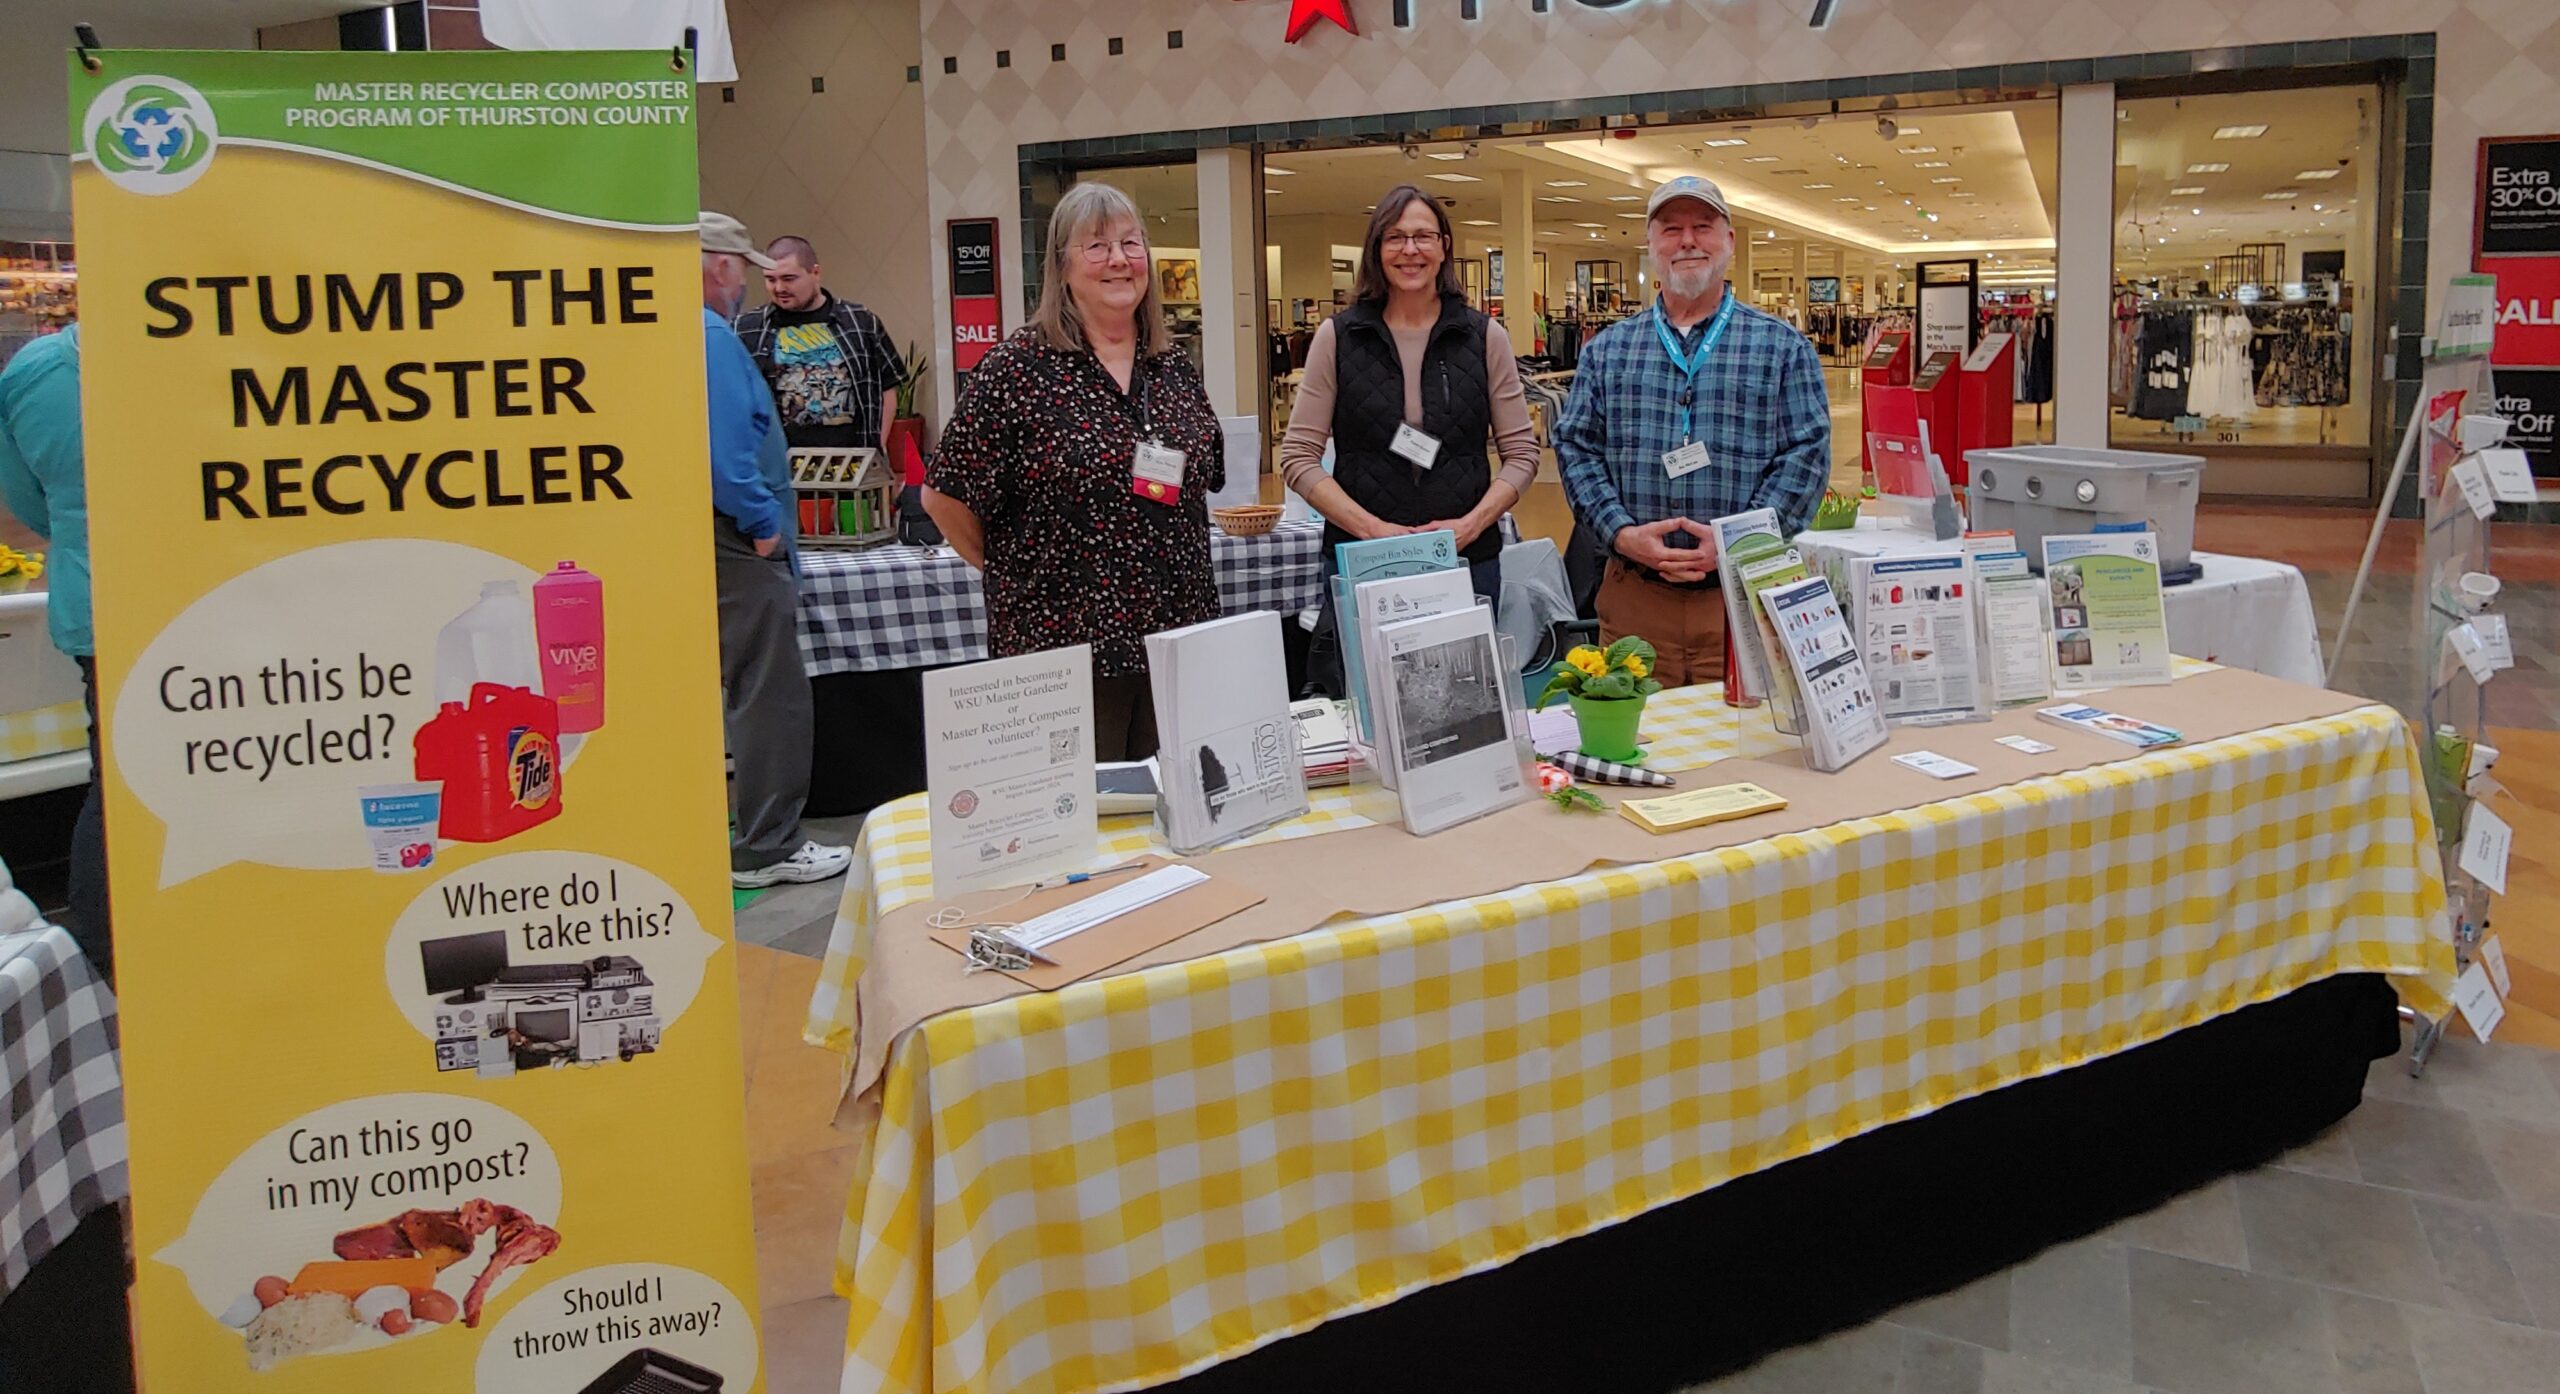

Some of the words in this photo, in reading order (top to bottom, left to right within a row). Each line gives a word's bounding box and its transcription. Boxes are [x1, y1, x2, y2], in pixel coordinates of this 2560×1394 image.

[315, 82, 414, 103] MASTER
[420, 82, 540, 102] RECYCLER
[545, 82, 689, 101] COMPOSTER
[286, 106, 414, 128] PROGRAM
[420, 106, 452, 127] OF
[456, 106, 588, 127] THURSTON
[594, 104, 689, 126] COUNTY
[2493, 167, 2550, 186] Extra
[2490, 187, 2535, 207] 30%
[2536, 186, 2560, 206] Of
[957, 246, 973, 259] 15%
[974, 245, 991, 258] Off
[145, 272, 464, 339] STUMP
[493, 266, 659, 329] THE
[955, 325, 998, 343] SALE
[1926, 323, 1943, 332] Shop
[1927, 344, 1948, 352] Macy's
[230, 356, 595, 428] MASTER
[2495, 394, 2531, 411] xtra
[2217, 432, 2240, 443] 301
[2517, 413, 2555, 433] Off
[202, 444, 632, 522] RECYCLER
[160, 662, 244, 714] Can
[259, 658, 344, 708] this
[360, 652, 413, 701] be
[949, 679, 999, 698] Interested
[1003, 678, 1013, 688] in
[1016, 669, 1063, 684] becoming
[954, 697, 982, 711] WSU
[987, 691, 1020, 705] Master
[1024, 681, 1068, 697] Gardener
[942, 726, 978, 741] Master
[982, 718, 1026, 735] Recycler
[1029, 705, 1081, 723] Composter
[1008, 705, 1019, 714] or
[186, 713, 397, 782] recycled?
[988, 727, 1040, 745] volunteer?
[516, 749, 550, 801] Tide
[443, 874, 550, 919] Where
[559, 872, 600, 908] do
[610, 868, 617, 902] I
[523, 915, 592, 951] take
[600, 903, 674, 943] this?
[288, 1126, 349, 1166] Can
[358, 1119, 421, 1158] this
[432, 1118, 473, 1153] go
[267, 1178, 300, 1211] in
[310, 1175, 359, 1212] my
[371, 1142, 529, 1196] compost?
[563, 1278, 649, 1316] Should
[656, 1276, 662, 1302] I
[513, 1325, 587, 1359] throw
[595, 1316, 642, 1343] this
[648, 1303, 722, 1341] away?
